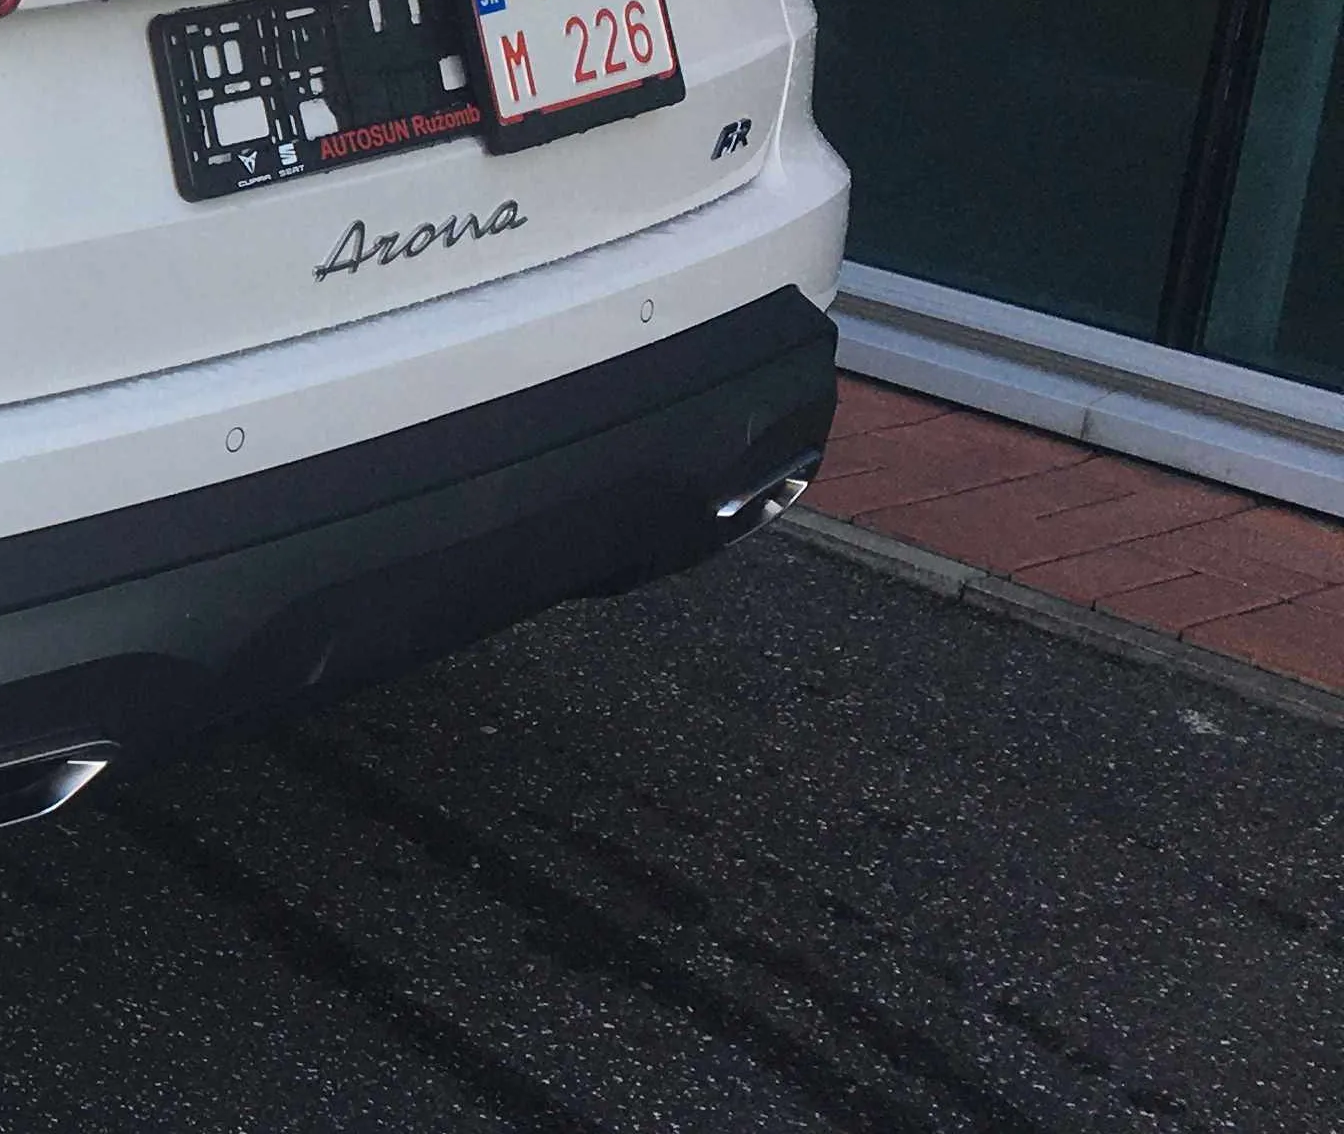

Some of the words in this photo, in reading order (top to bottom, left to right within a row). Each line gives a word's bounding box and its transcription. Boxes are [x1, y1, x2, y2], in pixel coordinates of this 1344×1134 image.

[499, 30, 537, 102] M
[564, 0, 653, 84] 226
[319, 119, 409, 160] AUTOSUN
[412, 103, 481, 138] Ružomb
[710, 118, 752, 161] FR
[238, 173, 272, 188] CUPRA
[278, 164, 305, 177] SEAT
[312, 199, 528, 283] Arona
